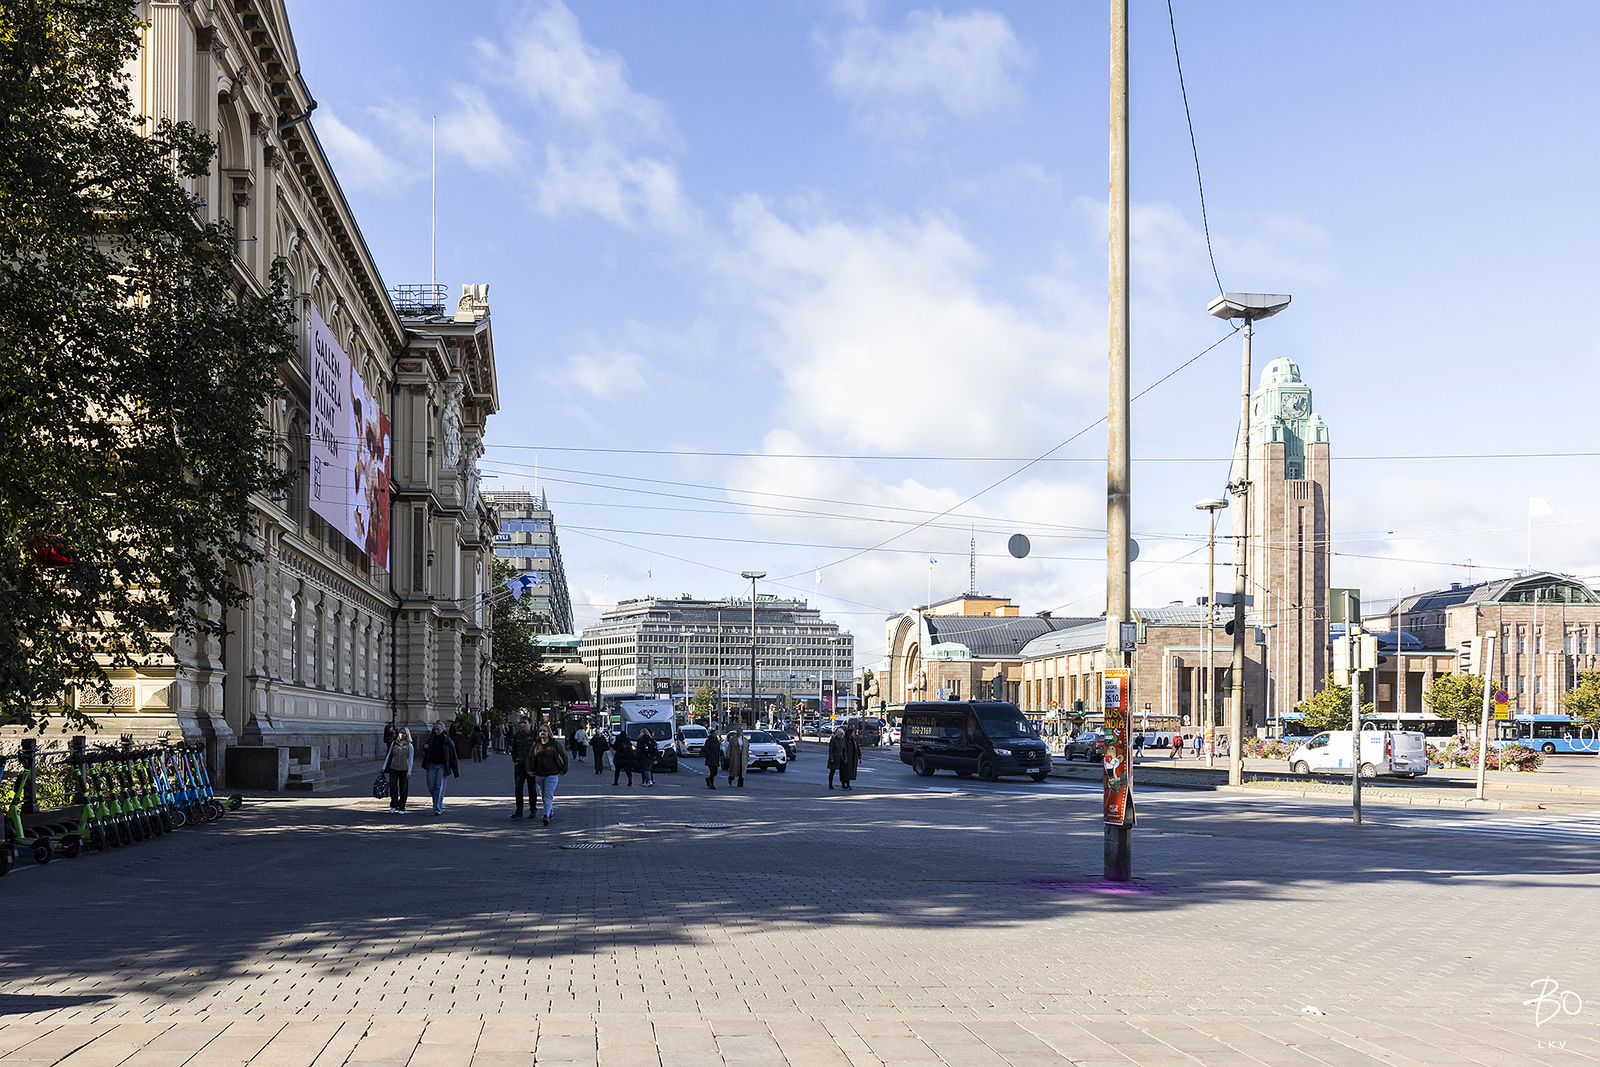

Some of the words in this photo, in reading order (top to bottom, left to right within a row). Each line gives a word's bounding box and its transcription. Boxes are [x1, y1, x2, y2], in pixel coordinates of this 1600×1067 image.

[315, 330, 341, 381] GALLEN-
[314, 386, 335, 428] KLIMT
[315, 357, 342, 412] KALLELA
[314, 414, 321, 440] &
[321, 422, 339, 459] WIEN
